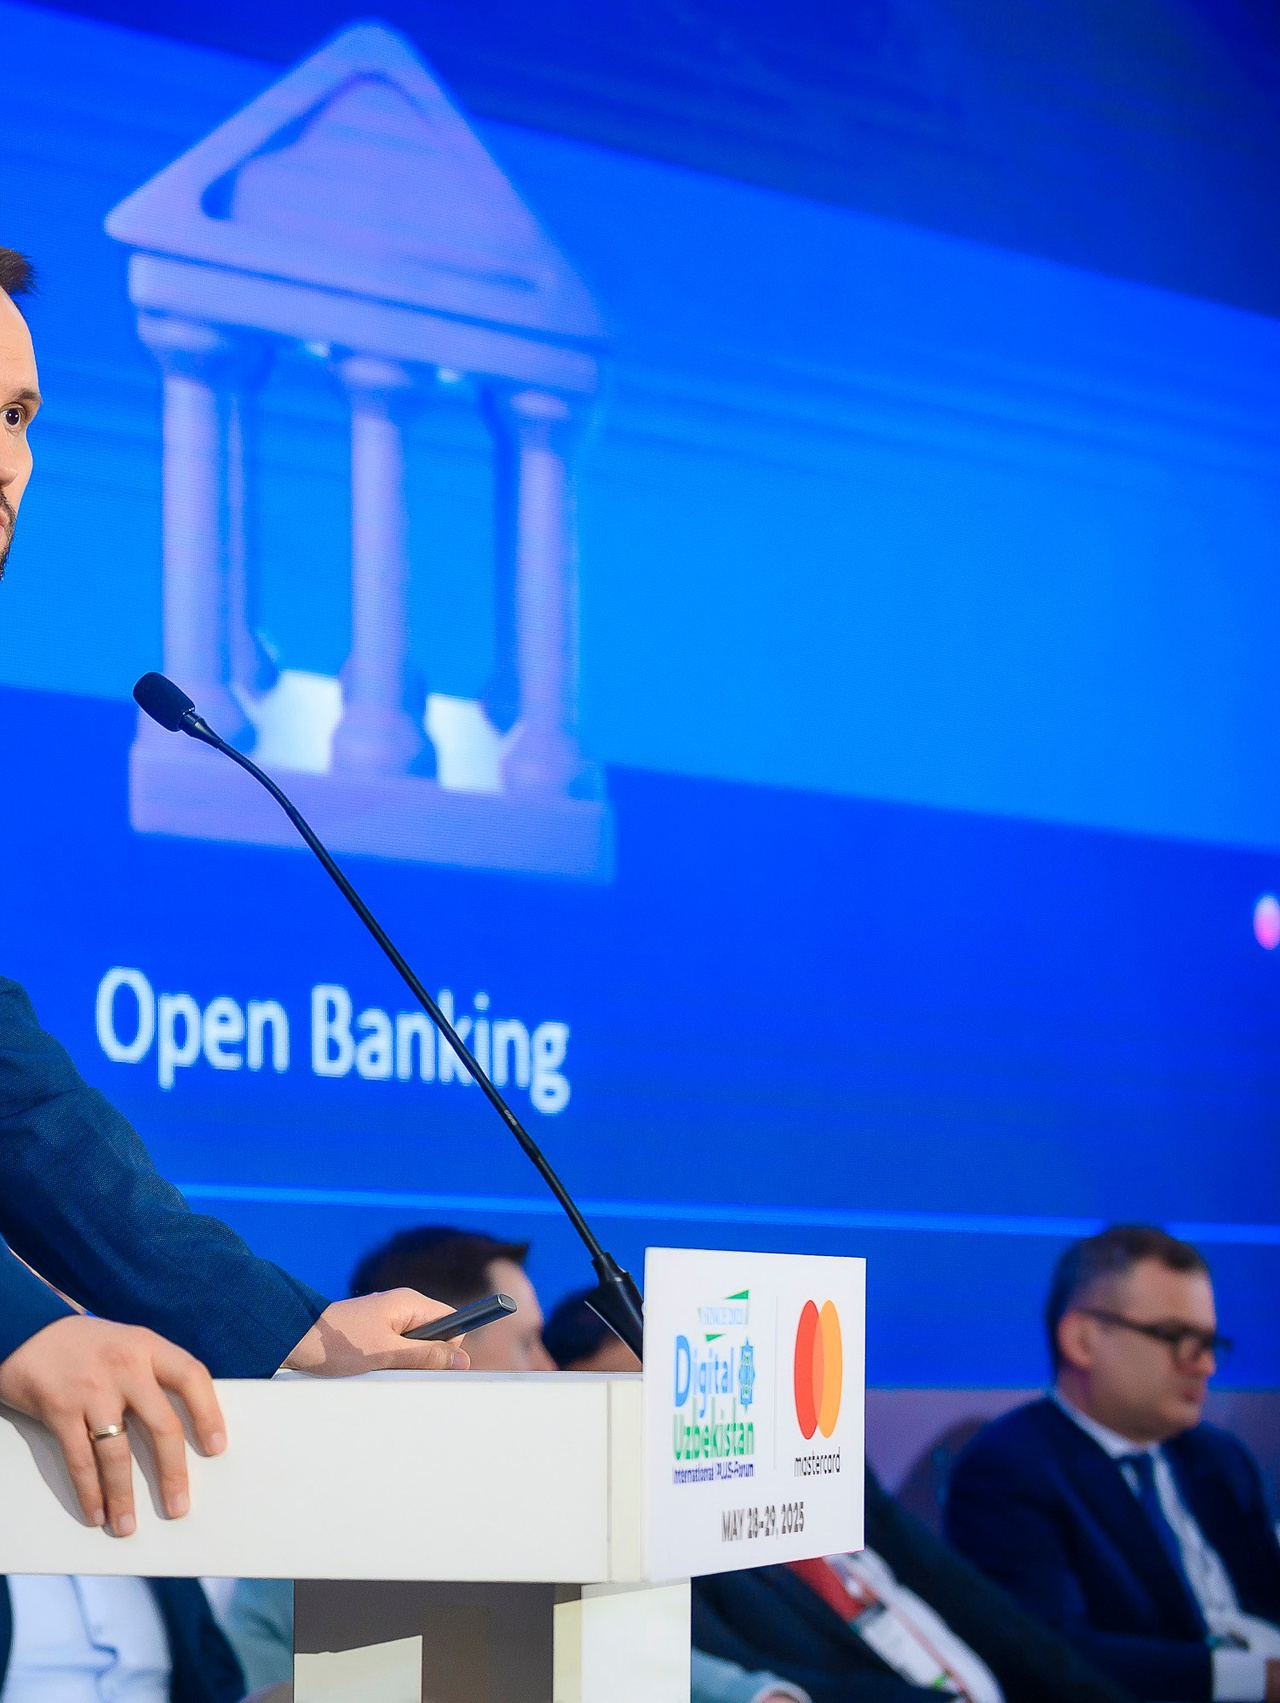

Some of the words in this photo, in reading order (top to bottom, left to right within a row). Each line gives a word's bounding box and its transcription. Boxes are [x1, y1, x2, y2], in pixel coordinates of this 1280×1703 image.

[96, 966, 291, 1090] Open
[311, 983, 572, 1114] Banking
[675, 1335, 734, 1418] Digital
[673, 1396, 754, 1461] Uzbekistan
[673, 1464, 714, 1484] International
[794, 1446, 841, 1477] mastercard
[722, 1508, 745, 1542] MAY
[747, 1505, 778, 1539] 28-29,
[781, 1501, 804, 1534] 2025
